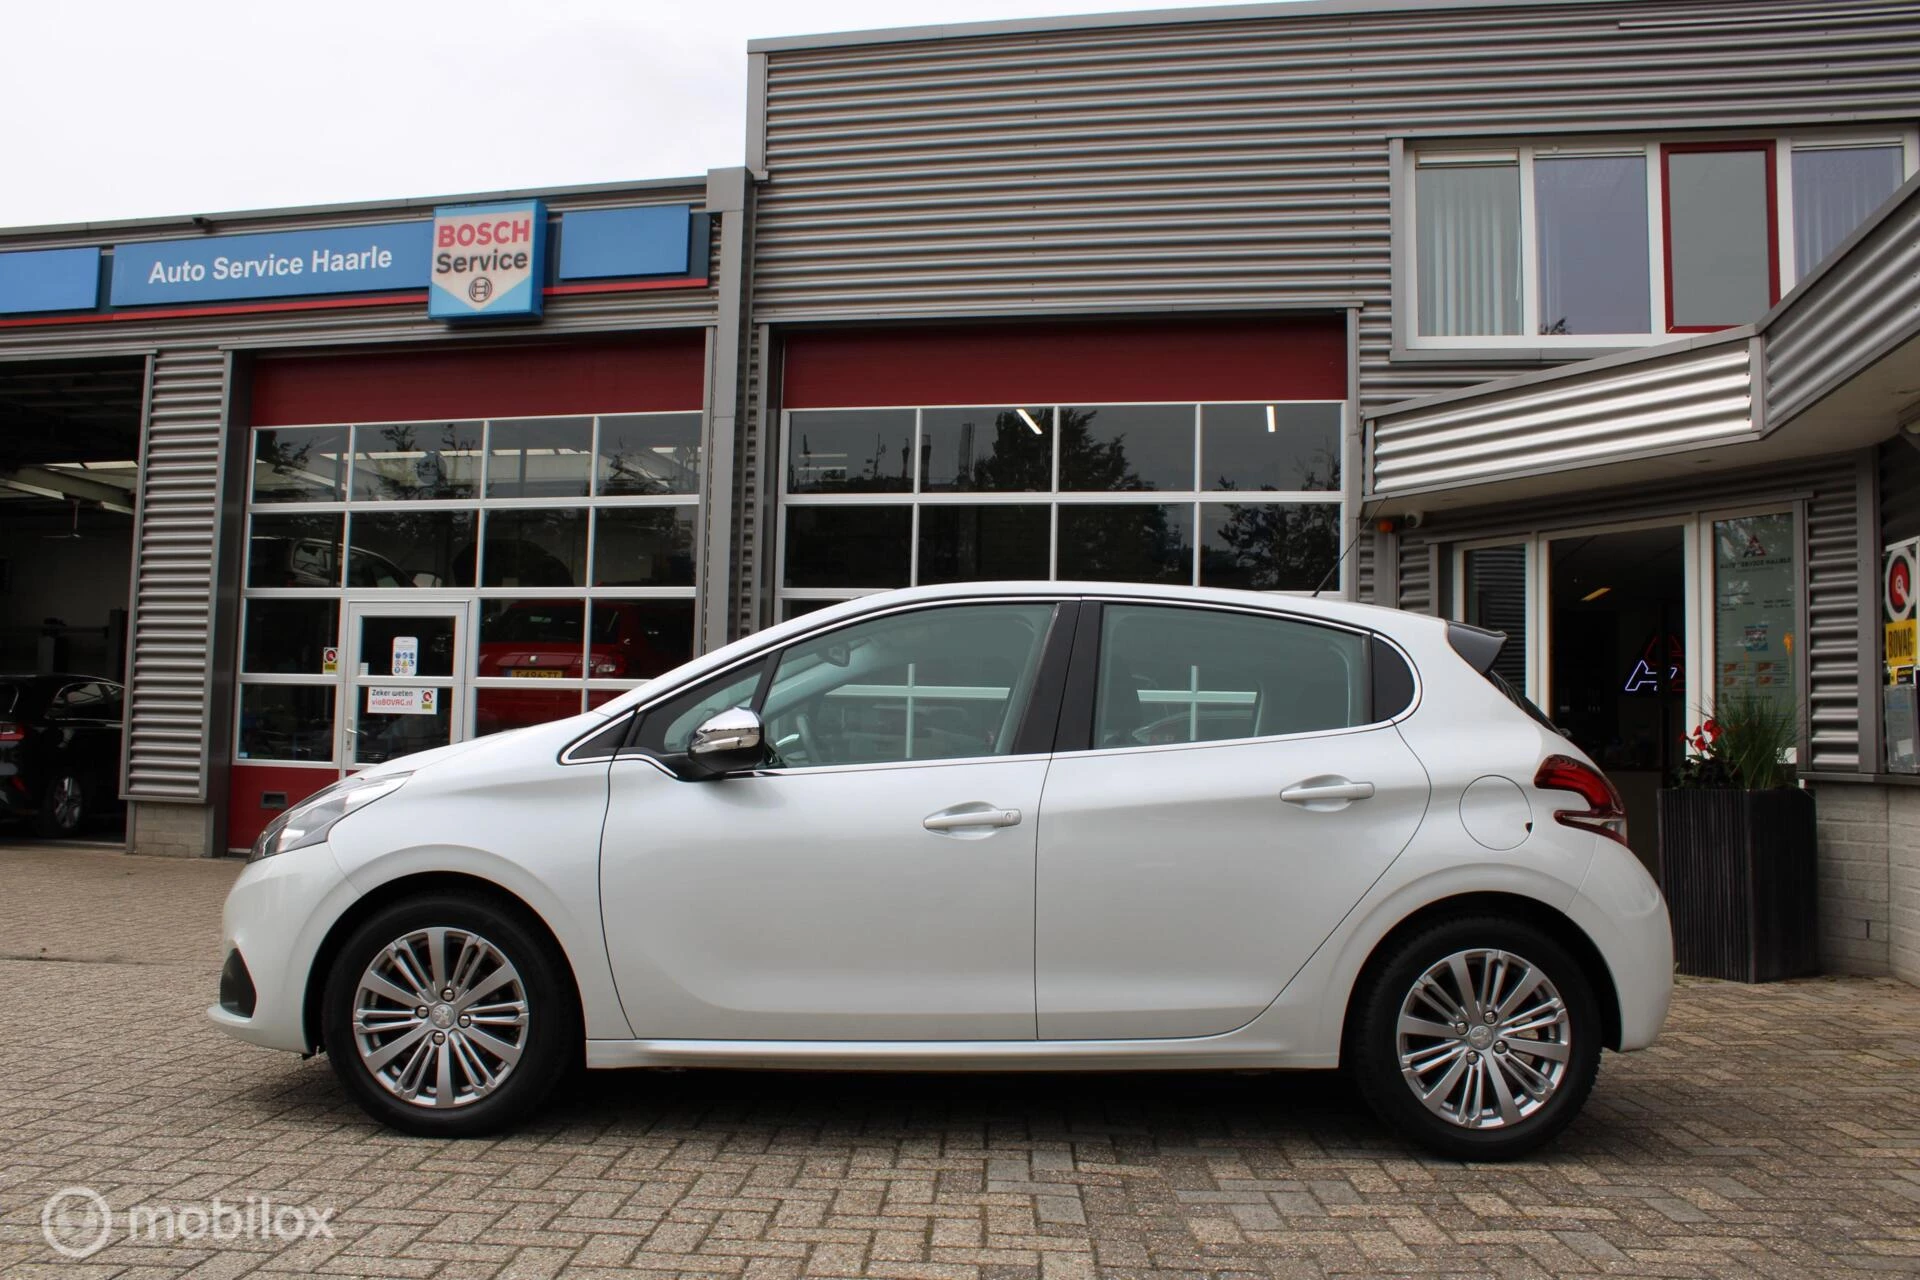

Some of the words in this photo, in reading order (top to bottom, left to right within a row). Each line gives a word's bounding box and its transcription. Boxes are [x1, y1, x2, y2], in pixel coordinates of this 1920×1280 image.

[437, 219, 531, 248] BOSCH
[147, 260, 206, 285] Auto
[212, 253, 304, 281] Service
[311, 245, 393, 274] Haarle
[435, 248, 529, 274] Service
[1888, 627, 1913, 658] BOVAG
[371, 689, 390, 697] Zeker
[391, 689, 414, 697] weten
